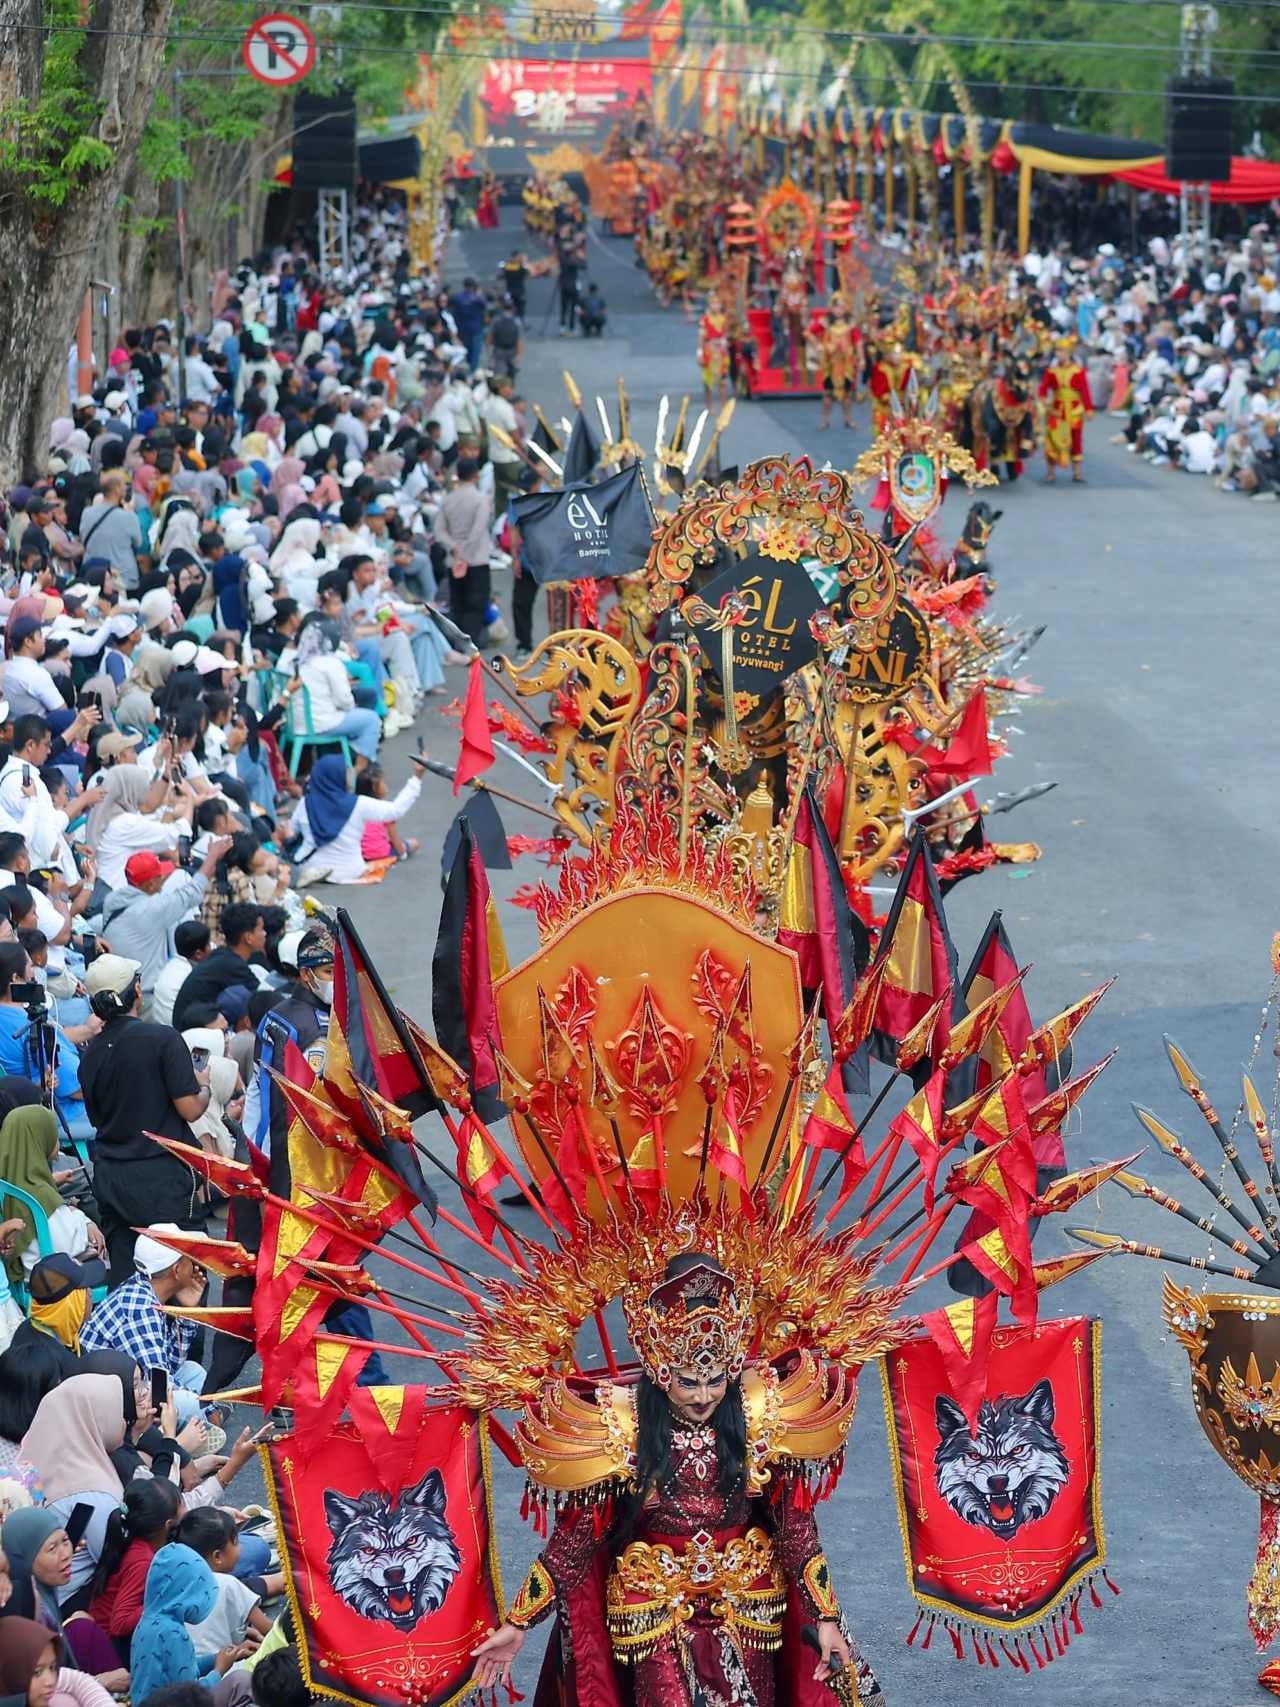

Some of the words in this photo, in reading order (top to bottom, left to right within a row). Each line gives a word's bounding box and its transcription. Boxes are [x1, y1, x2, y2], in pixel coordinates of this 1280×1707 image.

[268, 31, 295, 69] P
[733, 629, 791, 651] OTEL
[732, 654, 785, 673] anyuwangi
